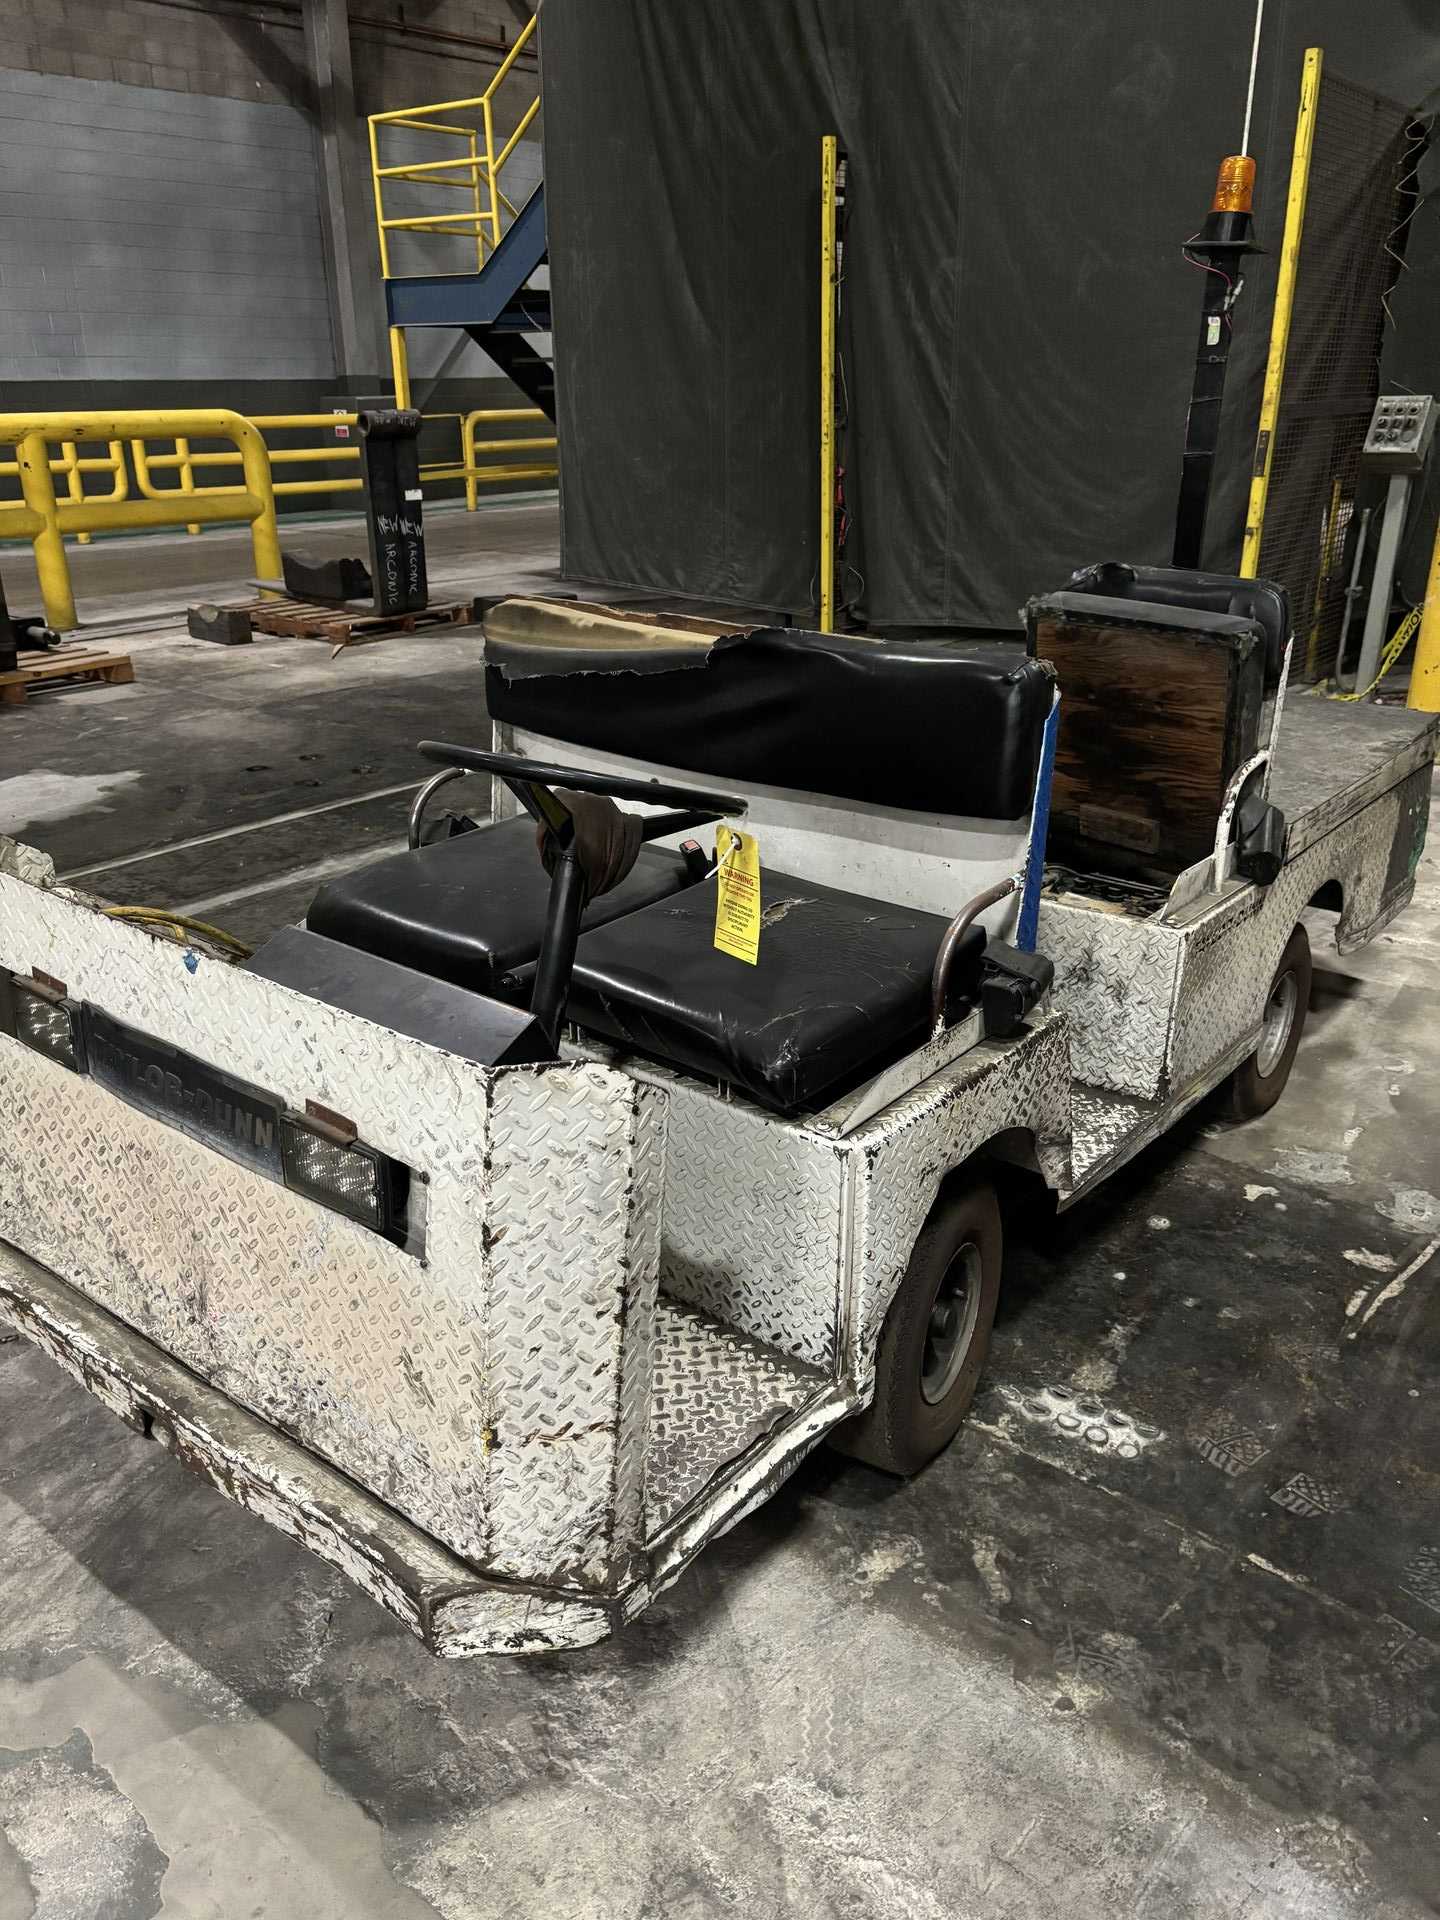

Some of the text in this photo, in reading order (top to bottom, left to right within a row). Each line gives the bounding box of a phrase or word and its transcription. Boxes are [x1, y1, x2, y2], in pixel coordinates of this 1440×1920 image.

[377, 513, 398, 535] NEW
[399, 518, 424, 537] NEW
[724, 868, 754, 886] WARNING
[94, 1032, 273, 1148] LOR-DUNN
